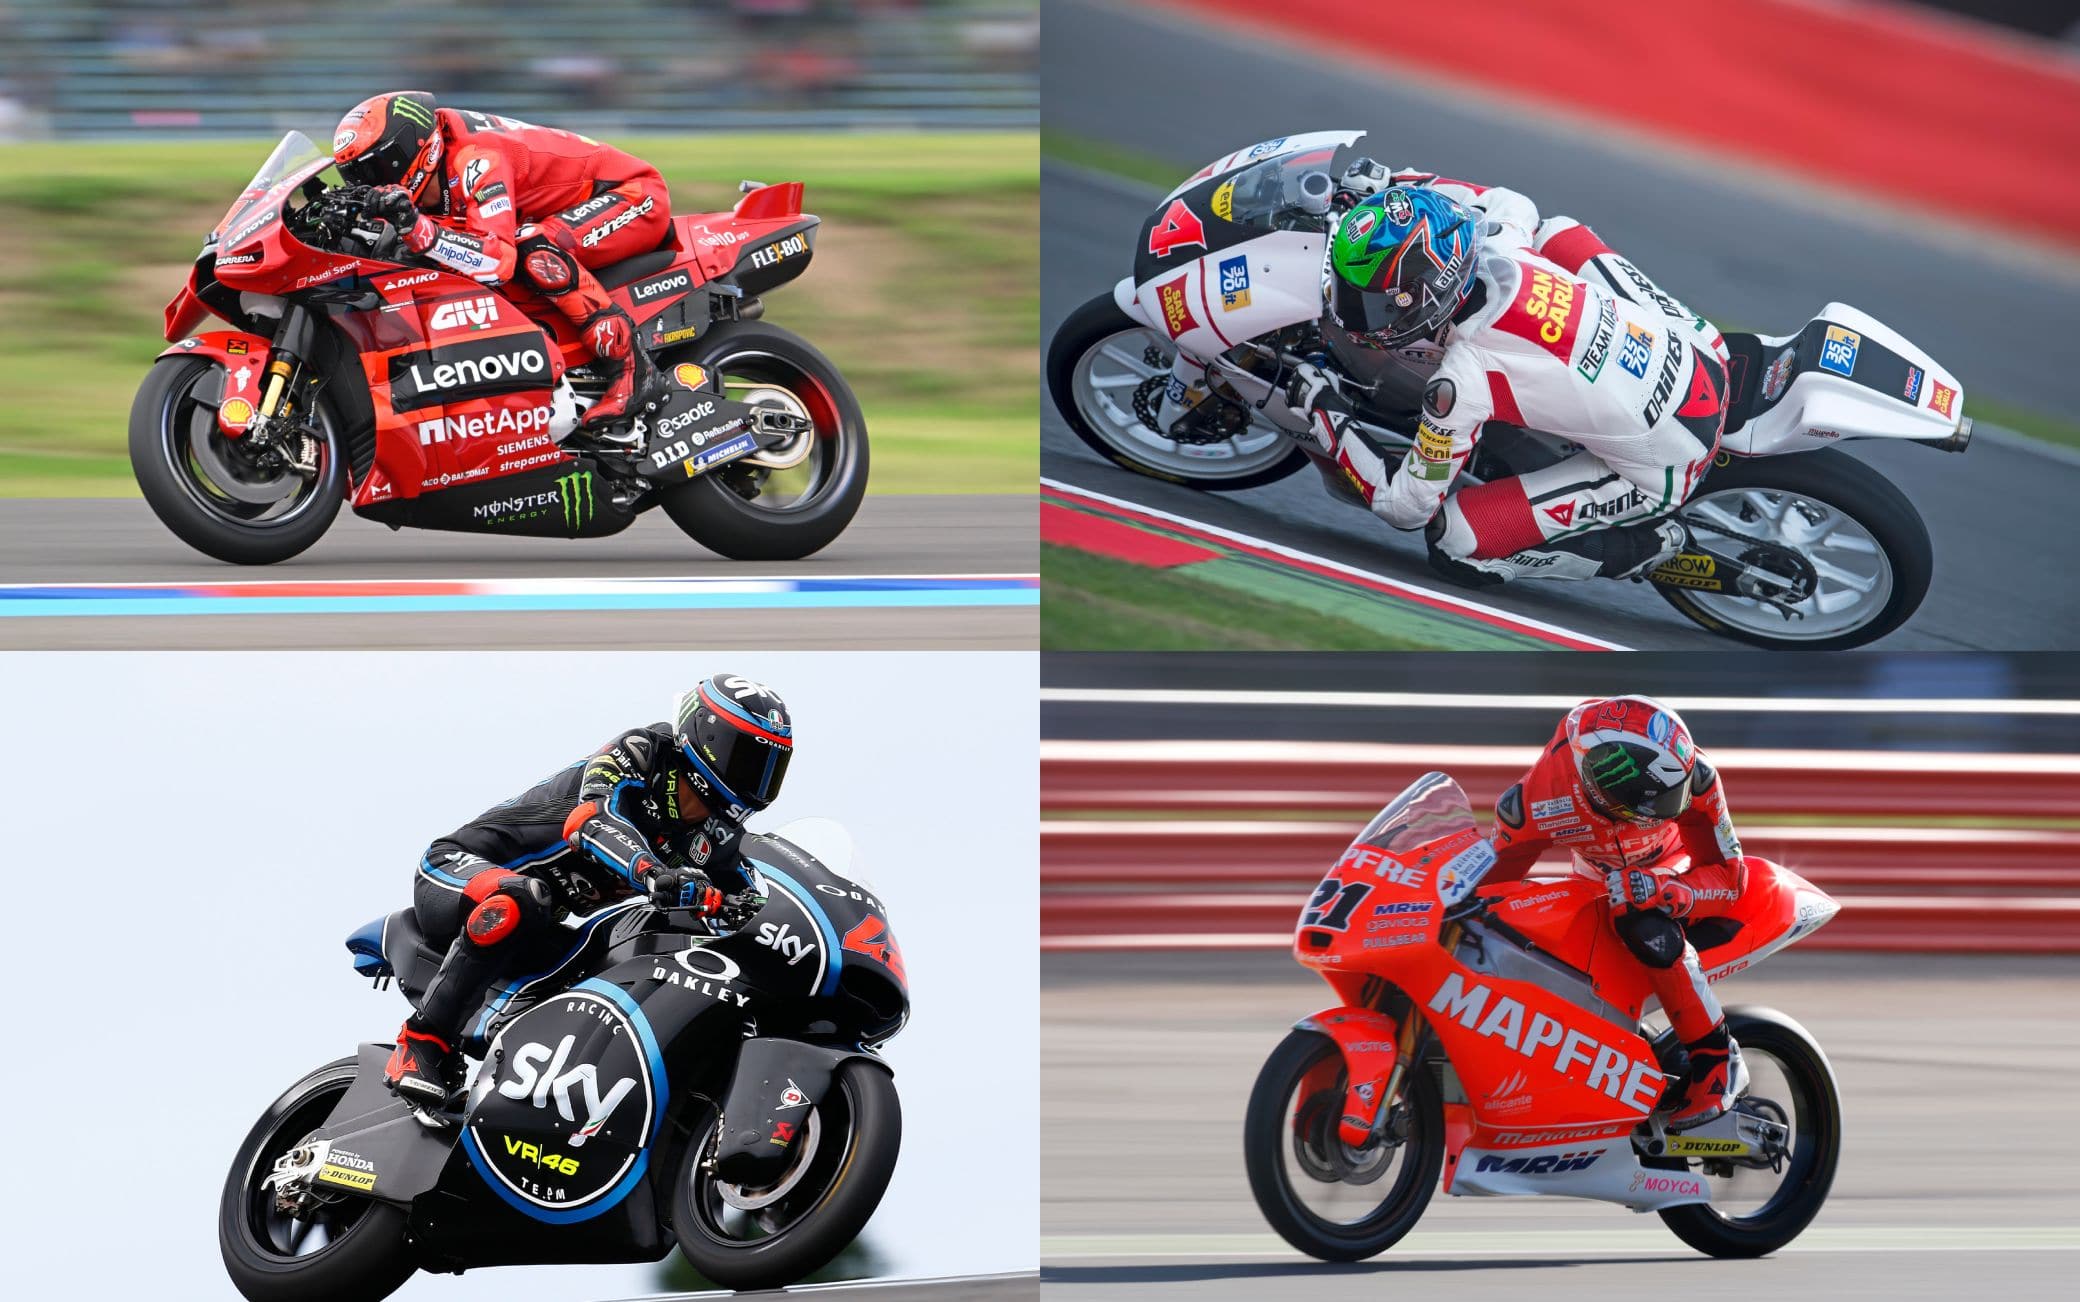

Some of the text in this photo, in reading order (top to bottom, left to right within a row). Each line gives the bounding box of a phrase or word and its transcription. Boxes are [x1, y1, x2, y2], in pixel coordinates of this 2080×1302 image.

[1219, 191, 1230, 218] eni
[227, 211, 274, 247] Lenovo
[441, 230, 481, 250] Lenovo
[1149, 198, 1208, 258] 4
[216, 254, 255, 266] CARRERA
[751, 232, 809, 269] FLEX-BOX
[309, 260, 362, 284] Audi Sport
[397, 272, 440, 288] DAIKO
[1233, 265, 1246, 288] 35
[634, 275, 688, 300] Lenovo
[1526, 269, 1552, 320] SAN
[430, 297, 499, 330] GIVI
[1163, 286, 1181, 332] CARLO
[1172, 289, 1186, 321] SAN
[410, 350, 544, 393] Lenovo
[445, 405, 550, 441] NetApp
[497, 434, 549, 456] SIEMENS
[651, 440, 691, 469] D.I.D
[707, 440, 749, 464] MICHELIN
[1425, 446, 1450, 459] eni
[499, 450, 561, 472] streparava
[473, 490, 560, 518] MONSTER
[487, 508, 548, 525] ENERGY
[704, 814, 736, 846] sky
[1374, 902, 1433, 916] MRW
[1509, 889, 1570, 912] Mahindra
[1366, 917, 1430, 933] gaviota
[755, 922, 816, 966] sky
[652, 966, 750, 1008] OAKLEY
[567, 1001, 622, 1036] RACING
[1428, 972, 1664, 1115] MAPFRE
[498, 1034, 637, 1147] sky
[1484, 1094, 1533, 1111] alicante
[1493, 1125, 1620, 1145] Mahindra
[1683, 1142, 1741, 1153] DUNLOP
[326, 1153, 375, 1171] HONDA
[1475, 1149, 1607, 1174] MRW
[330, 1170, 373, 1186] DUNLOP
[1645, 1178, 1700, 1195] MOYCA
